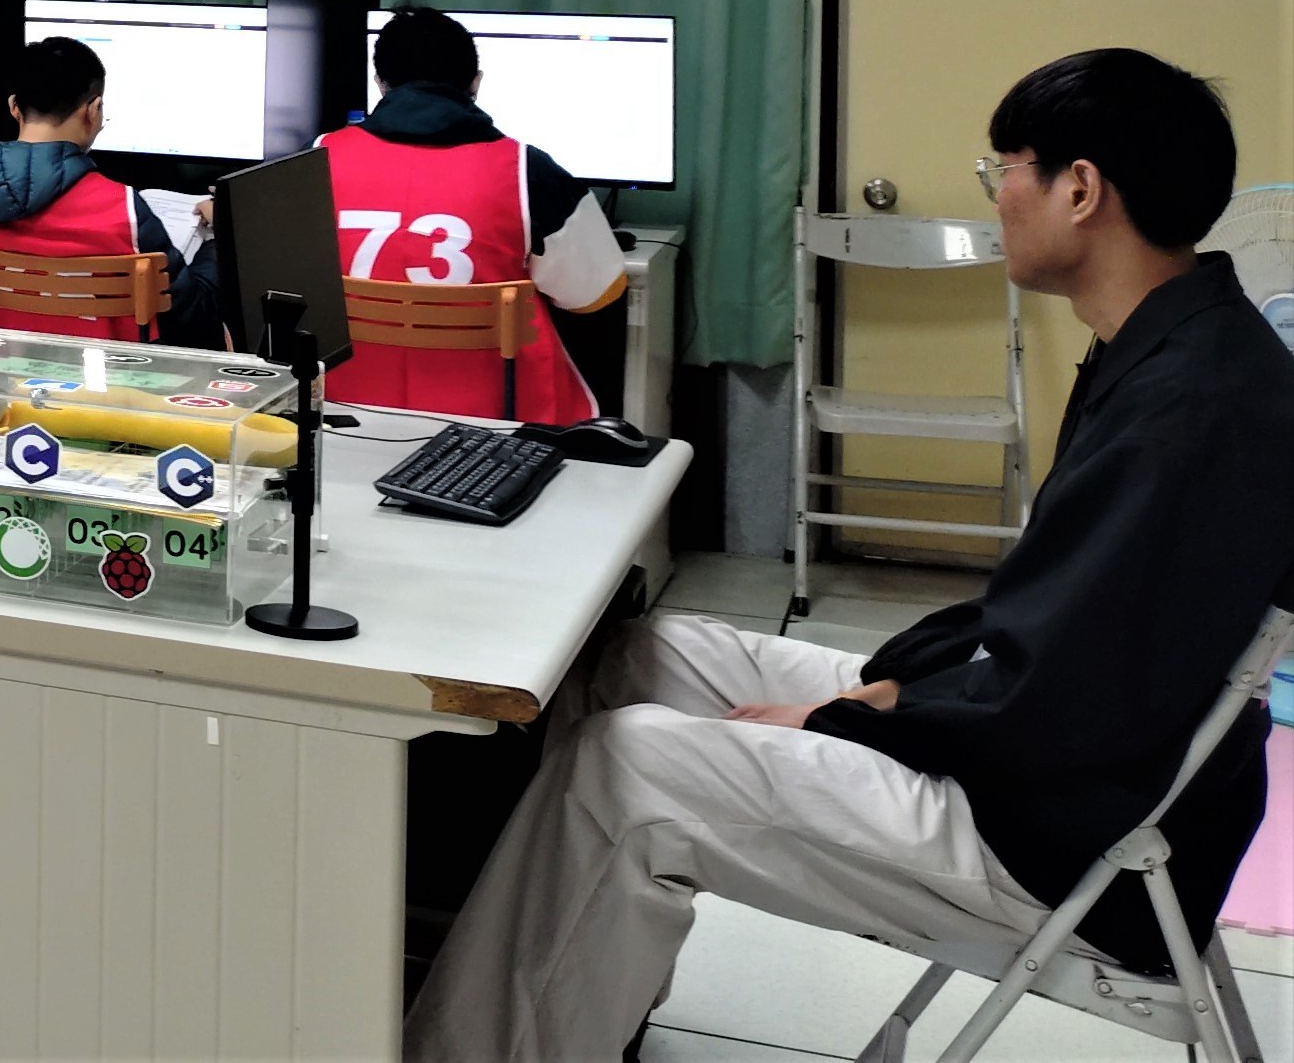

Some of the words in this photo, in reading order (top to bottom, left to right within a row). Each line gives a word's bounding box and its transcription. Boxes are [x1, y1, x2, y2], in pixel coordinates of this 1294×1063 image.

[338, 210, 475, 285] 73
[12, 434, 50, 476] C
[165, 458, 213, 497] C++
[164, 530, 209, 560] 04
